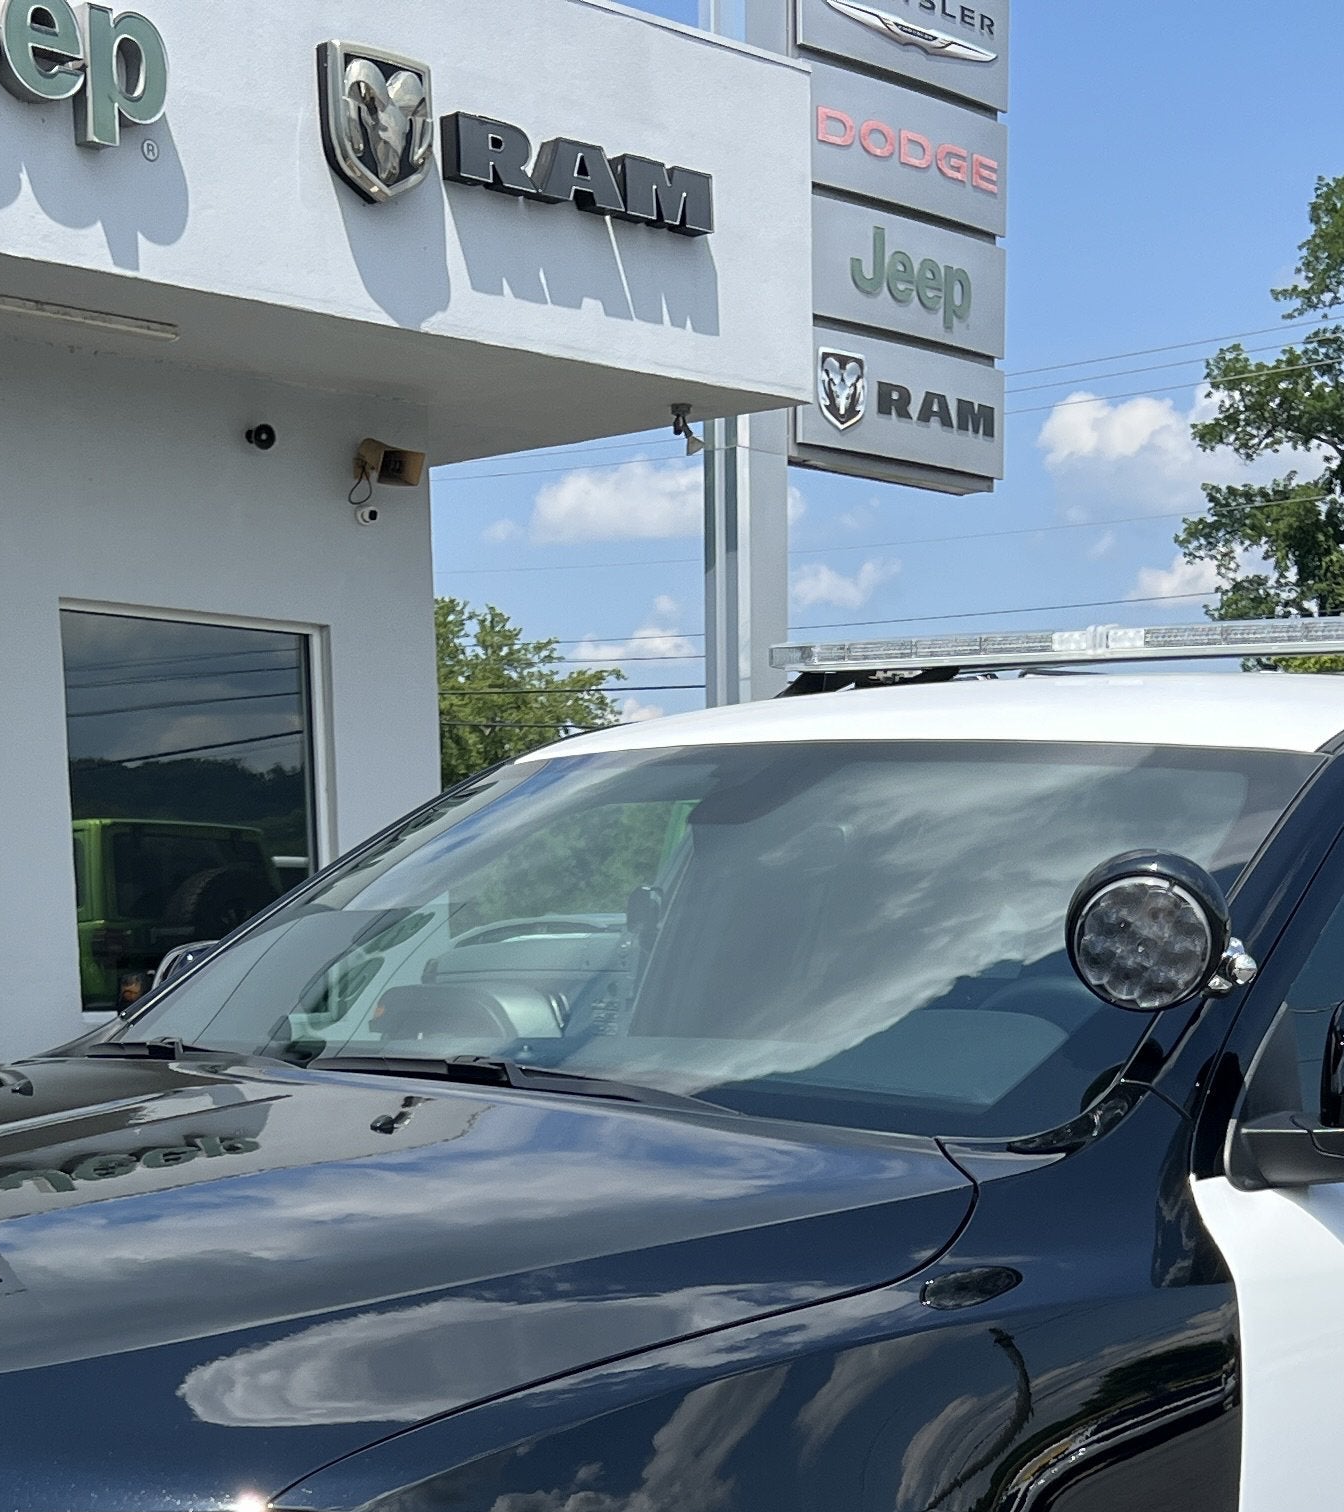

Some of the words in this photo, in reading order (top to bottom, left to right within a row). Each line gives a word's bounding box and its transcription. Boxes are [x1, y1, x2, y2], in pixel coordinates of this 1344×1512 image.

[440, 111, 714, 237] RAM
[816, 105, 998, 194] DODGE
[849, 225, 972, 330] Jeep
[877, 381, 996, 438] RAM
